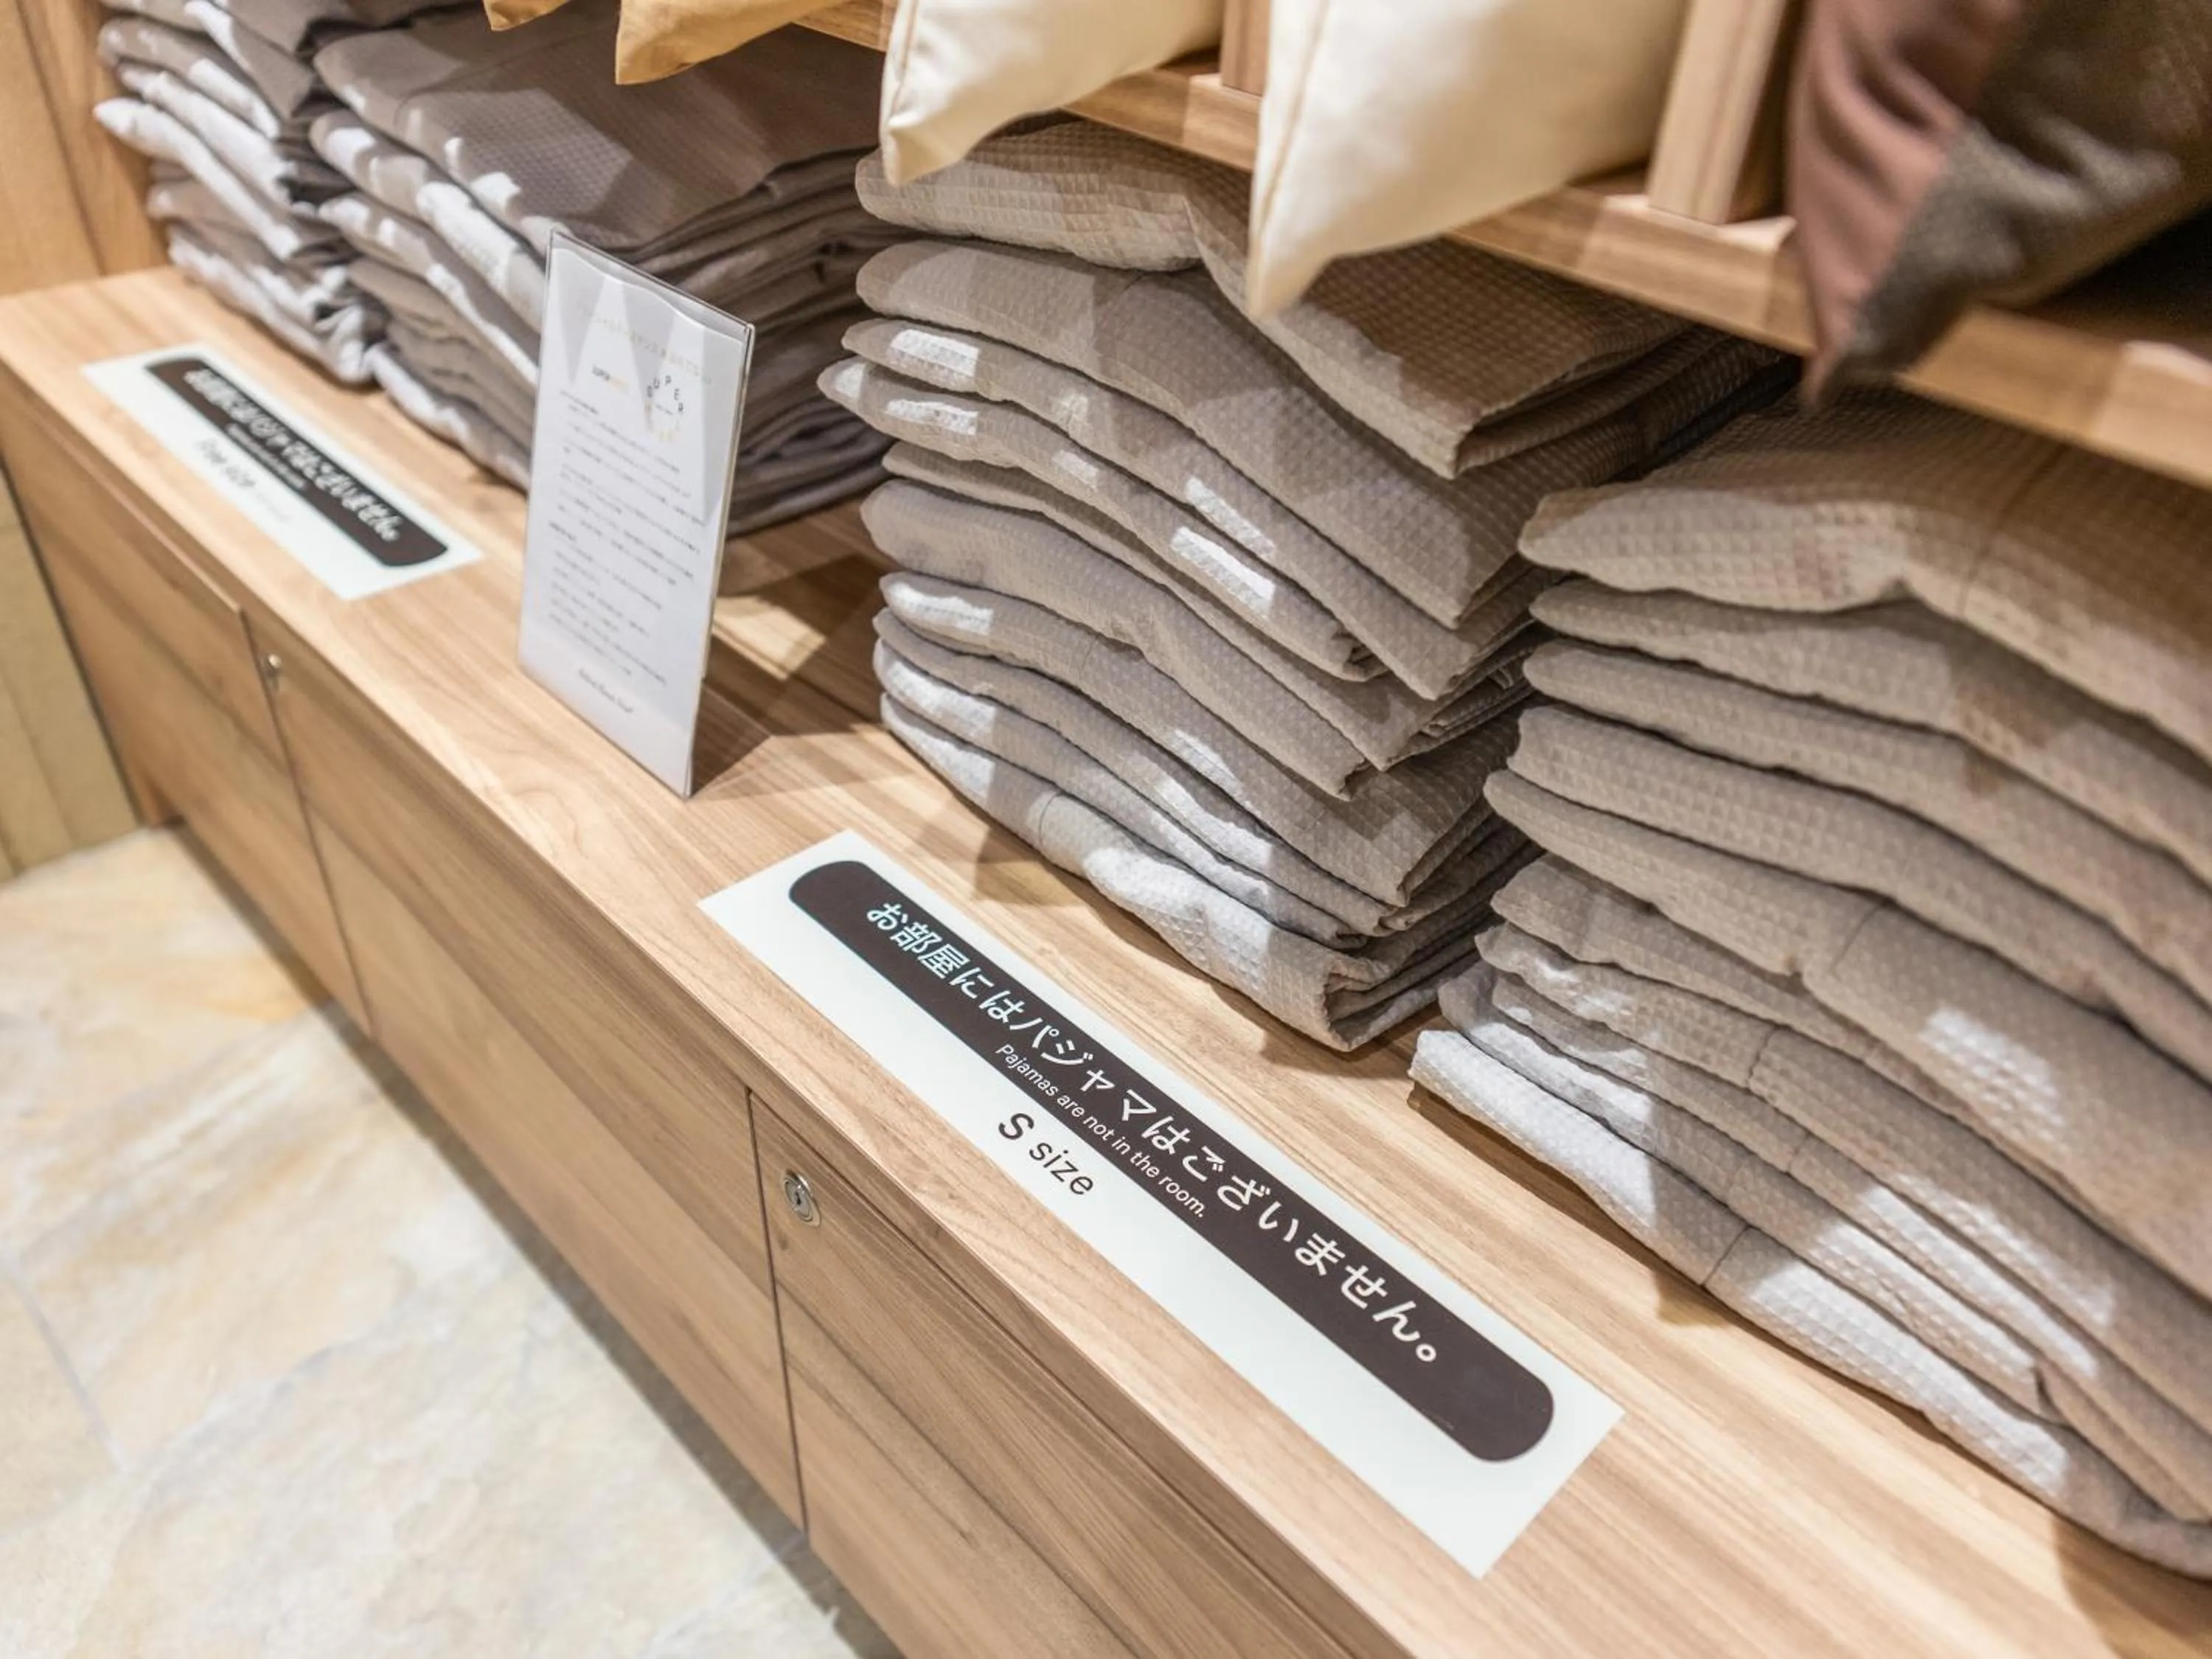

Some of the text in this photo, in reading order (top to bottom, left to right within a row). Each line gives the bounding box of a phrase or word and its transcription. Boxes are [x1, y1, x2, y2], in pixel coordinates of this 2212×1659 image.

[866, 900, 1438, 1363] お部屋にはパジャマはございません。
[995, 1043, 1206, 1217] Pajamas are not in the room.
[998, 1113, 1093, 1195] S size
